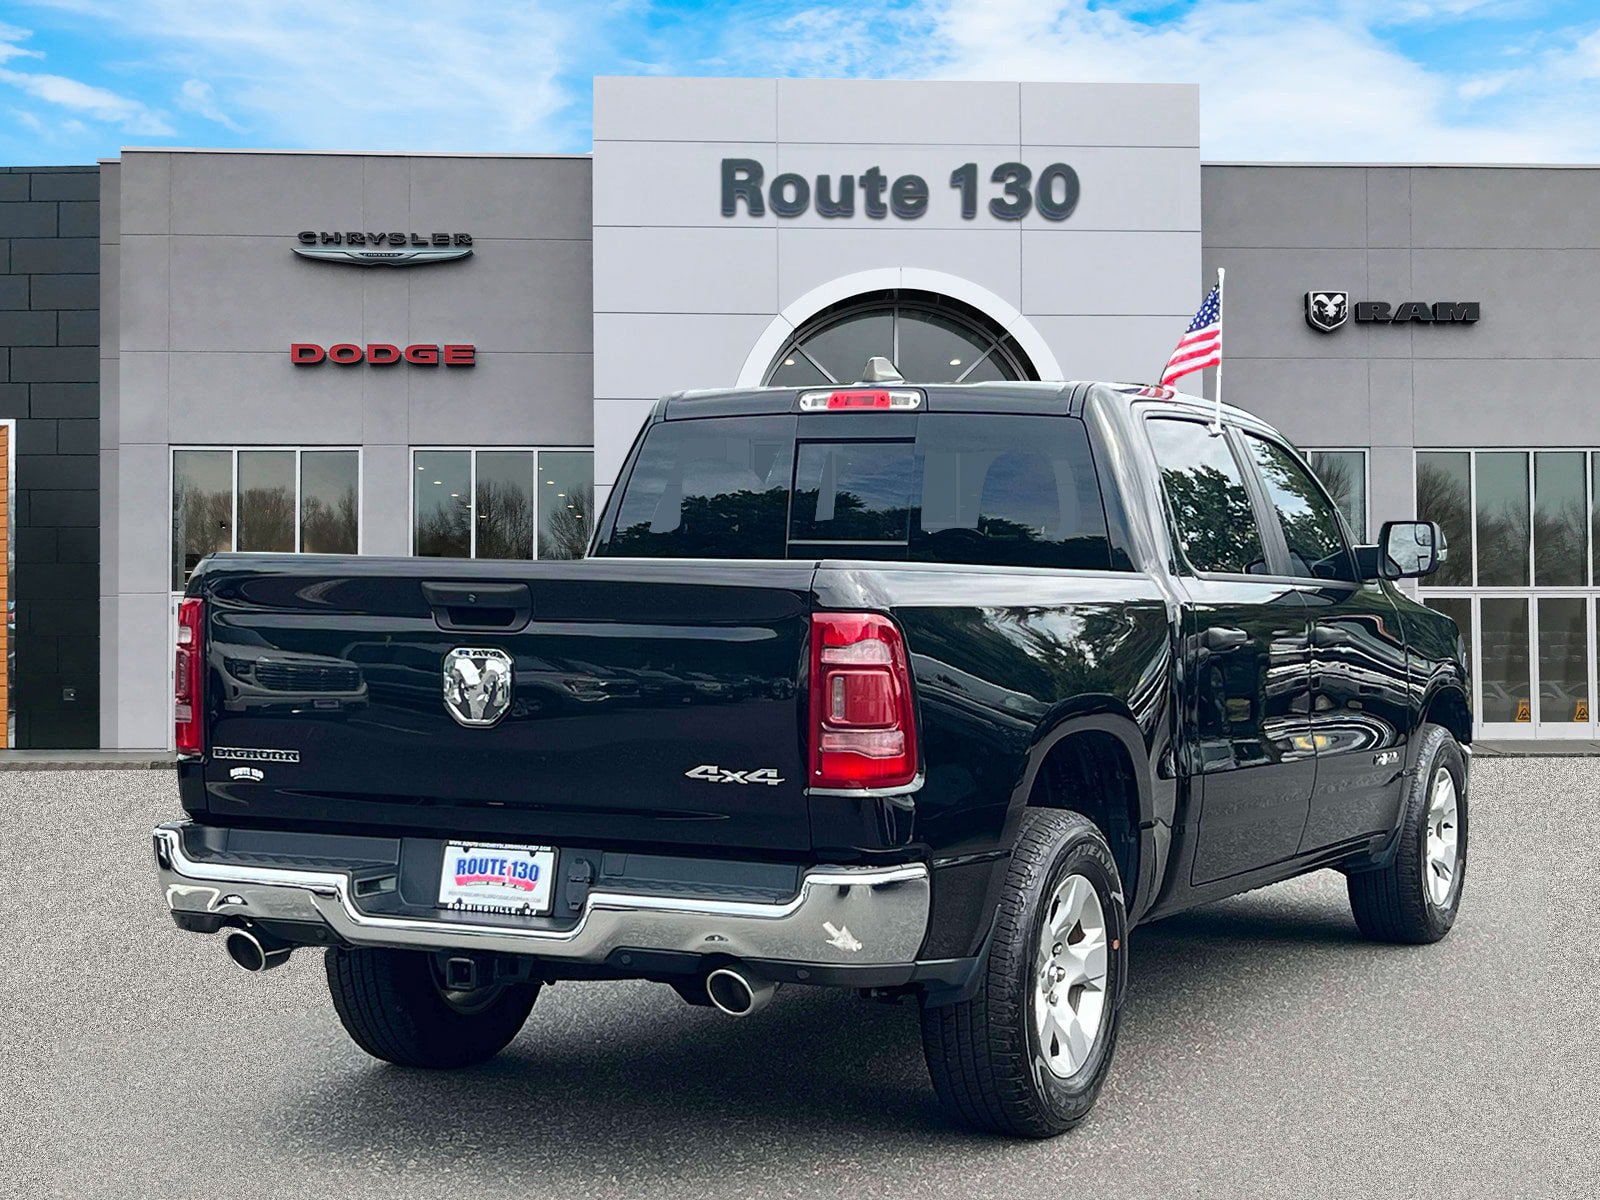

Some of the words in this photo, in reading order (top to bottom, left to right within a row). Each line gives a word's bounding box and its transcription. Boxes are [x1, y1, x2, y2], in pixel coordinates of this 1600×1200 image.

[721, 158, 929, 219] Route
[950, 162, 1080, 220] 130
[298, 231, 472, 246] CHRYSLER
[1354, 302, 1480, 324] RAM
[290, 343, 475, 367] DODGE
[685, 765, 785, 786] 4x4
[456, 858, 507, 876] ROUTE
[511, 861, 540, 882] 130
